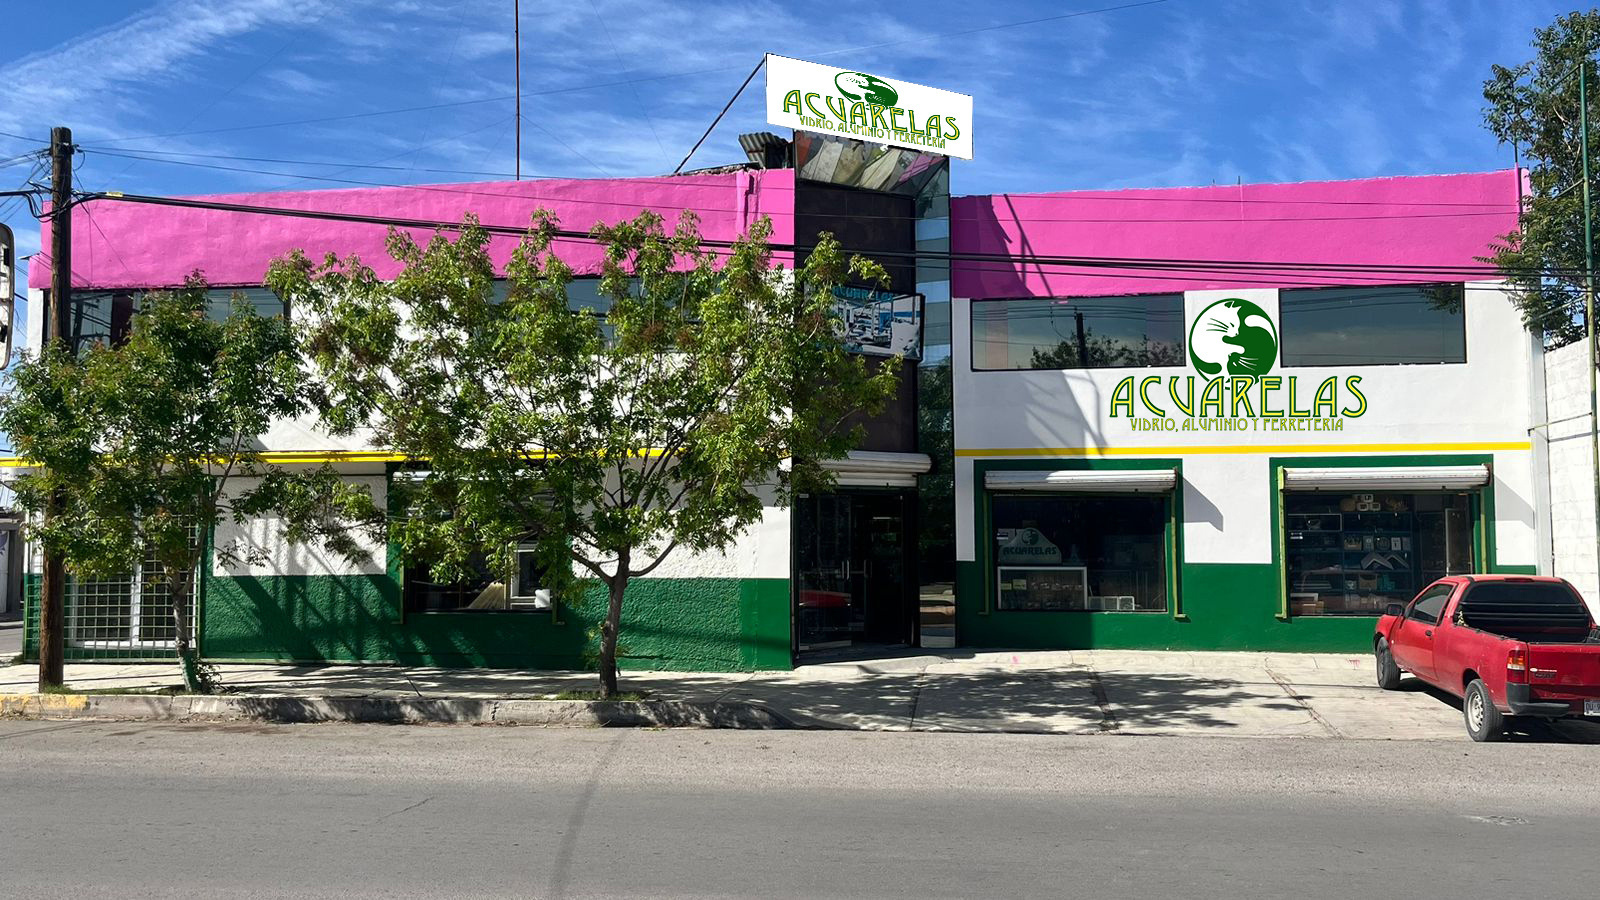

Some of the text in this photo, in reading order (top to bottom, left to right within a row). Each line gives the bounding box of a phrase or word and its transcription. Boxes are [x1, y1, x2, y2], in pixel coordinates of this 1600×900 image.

[783, 90, 960, 140] ACUARELAS
[838, 122, 885, 139] ALUMINIO
[886, 129, 892, 140] Y
[893, 130, 946, 149] FERRETERIA
[1109, 375, 1368, 418] ACUARELAS
[1130, 418, 1344, 433] VIDRIO, ALUMINIO Y FERRETERIA
[1003, 546, 1057, 555] ACUARELAS
